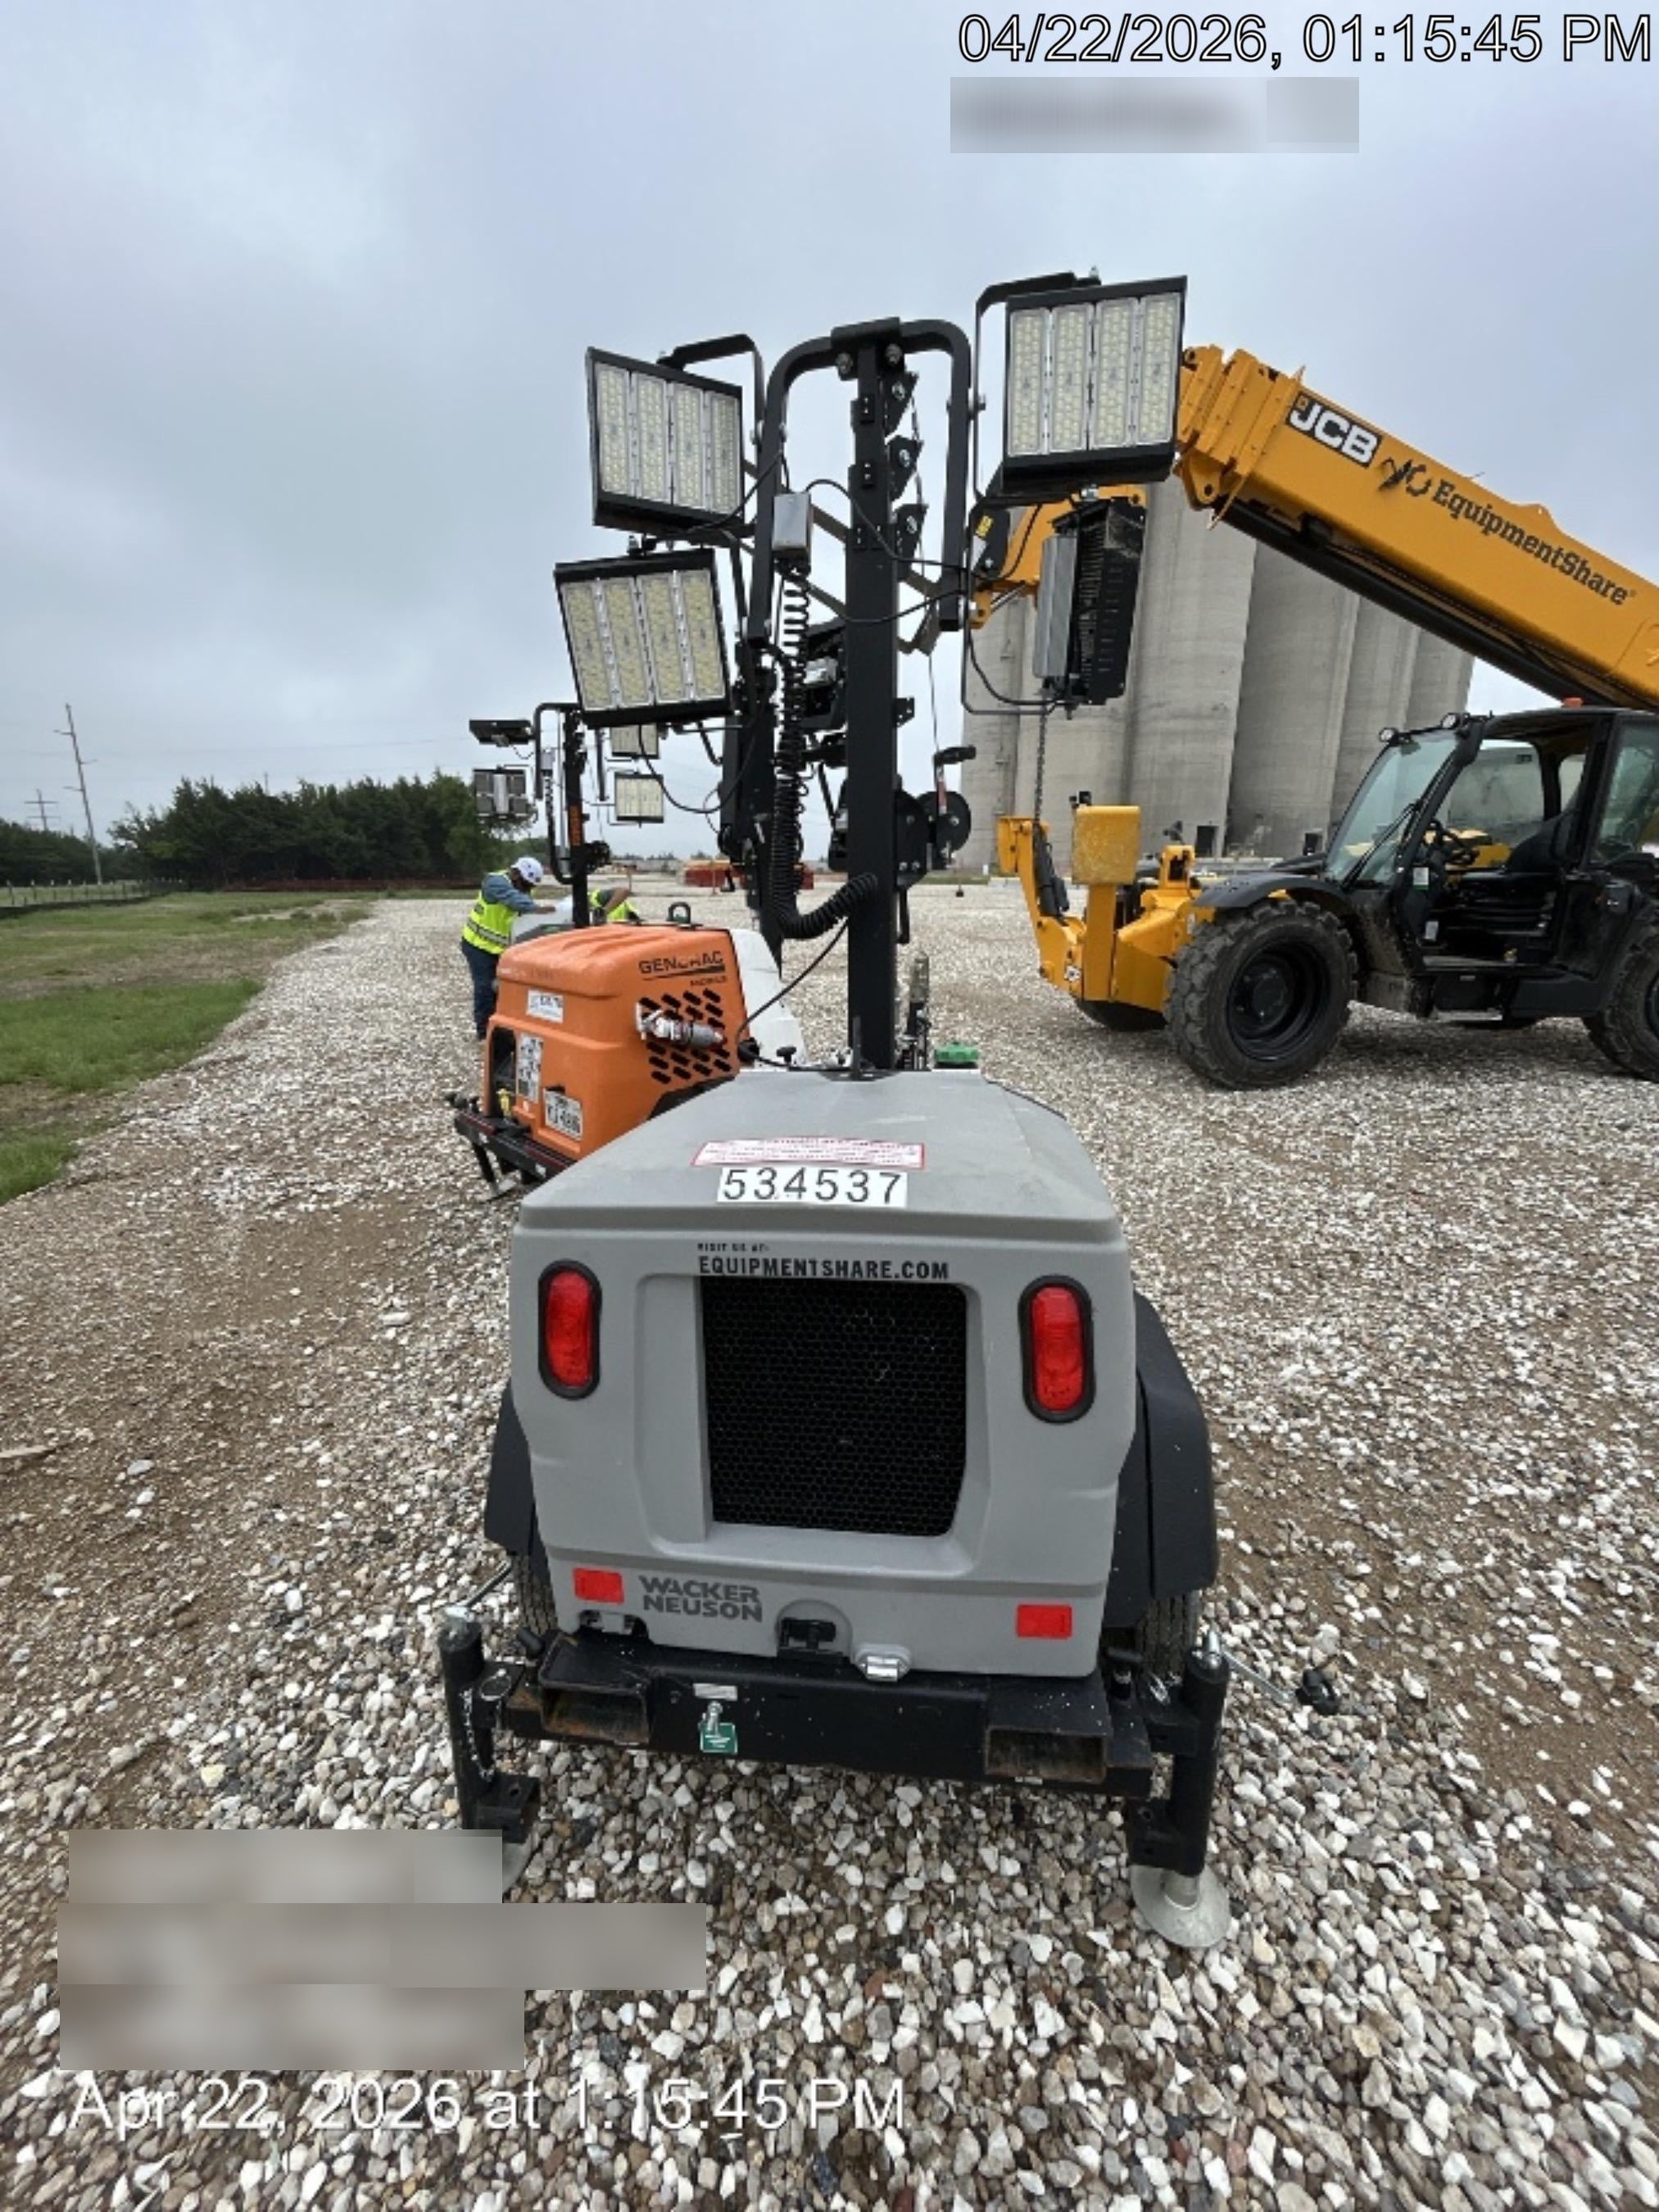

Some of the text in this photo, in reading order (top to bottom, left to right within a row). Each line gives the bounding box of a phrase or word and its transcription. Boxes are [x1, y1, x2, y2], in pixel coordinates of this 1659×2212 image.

[1289, 401, 1379, 464] JCB
[1432, 478, 1629, 605] EquipmentShare
[723, 1167, 901, 1204] 534537
[699, 1255, 949, 1280] EQUIPMENTSHARE.COM
[638, 1575, 759, 1603] WACKER
[643, 1594, 763, 1623] NEUSON
